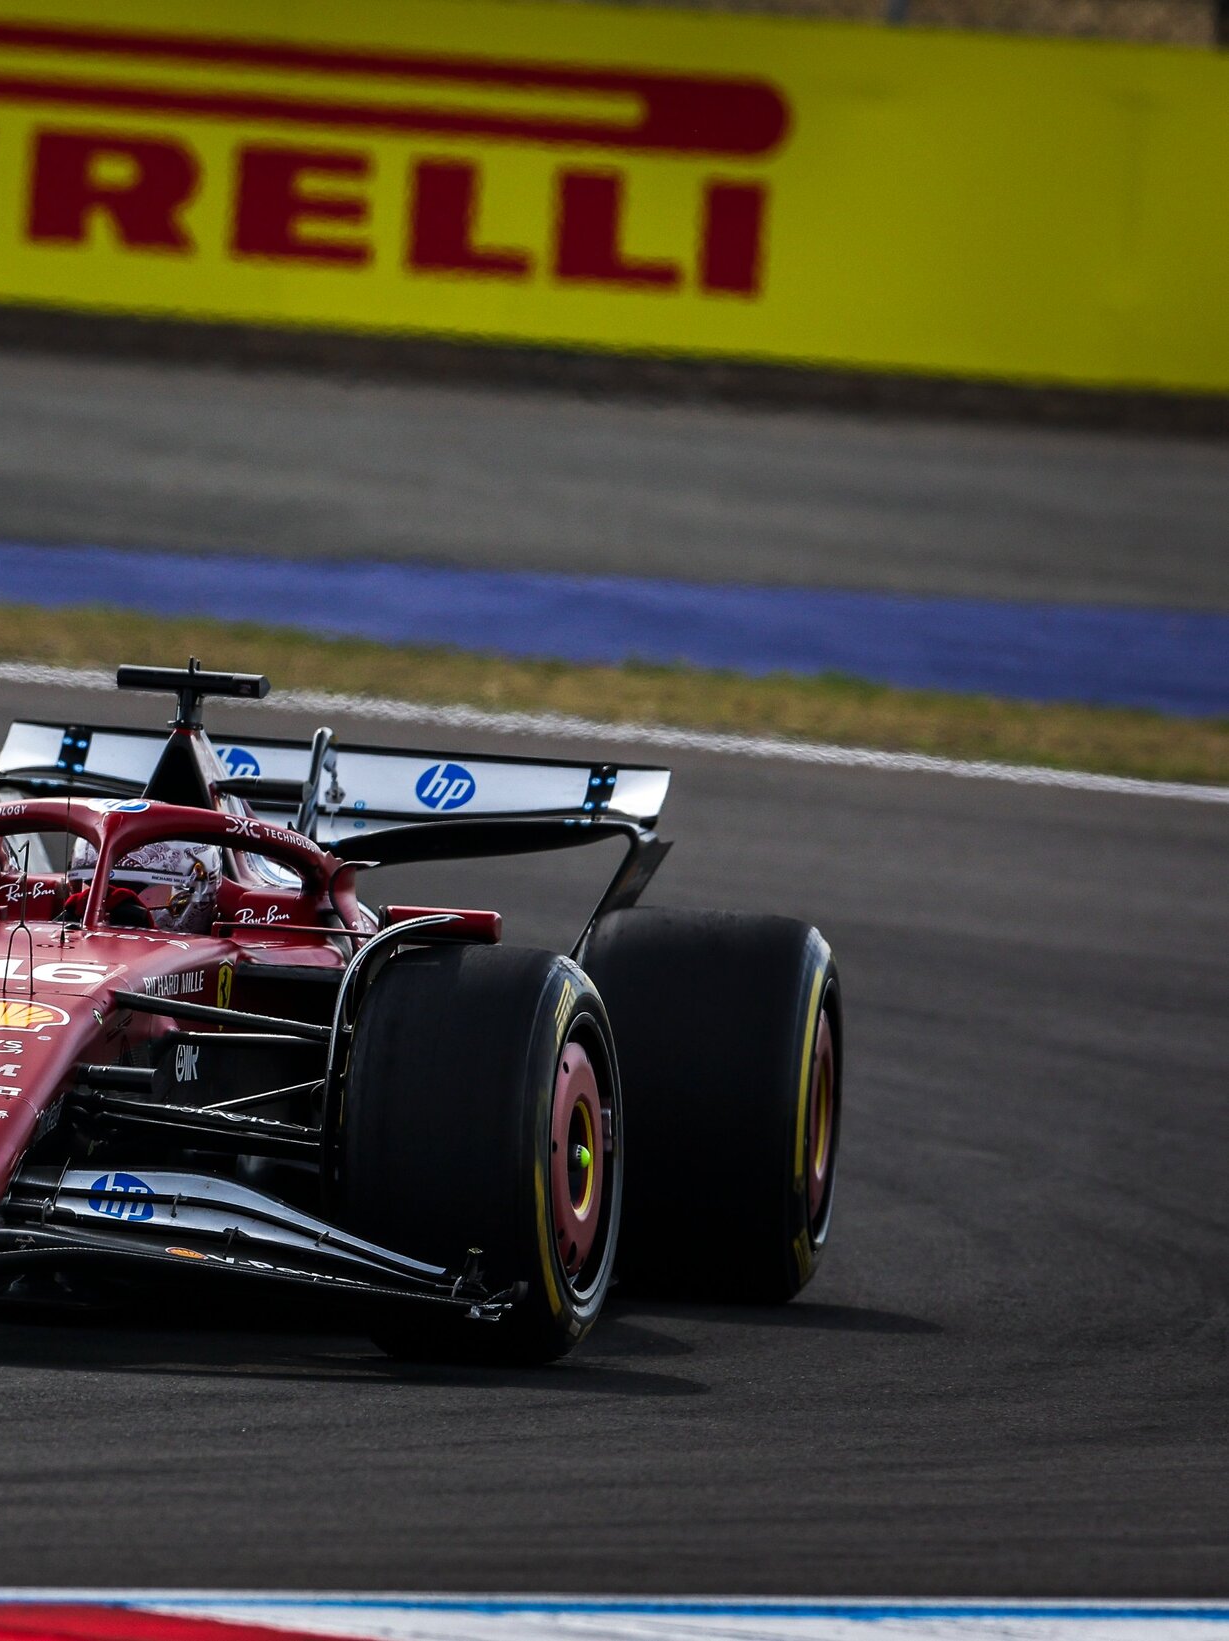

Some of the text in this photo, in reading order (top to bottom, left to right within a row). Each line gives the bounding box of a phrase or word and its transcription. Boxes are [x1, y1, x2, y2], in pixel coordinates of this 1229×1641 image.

[421, 763, 471, 810] hp
[225, 816, 320, 854] DXC TECHNOLOG
[143, 970, 205, 997] RICHARD MILLE
[96, 1172, 151, 1221] hp
